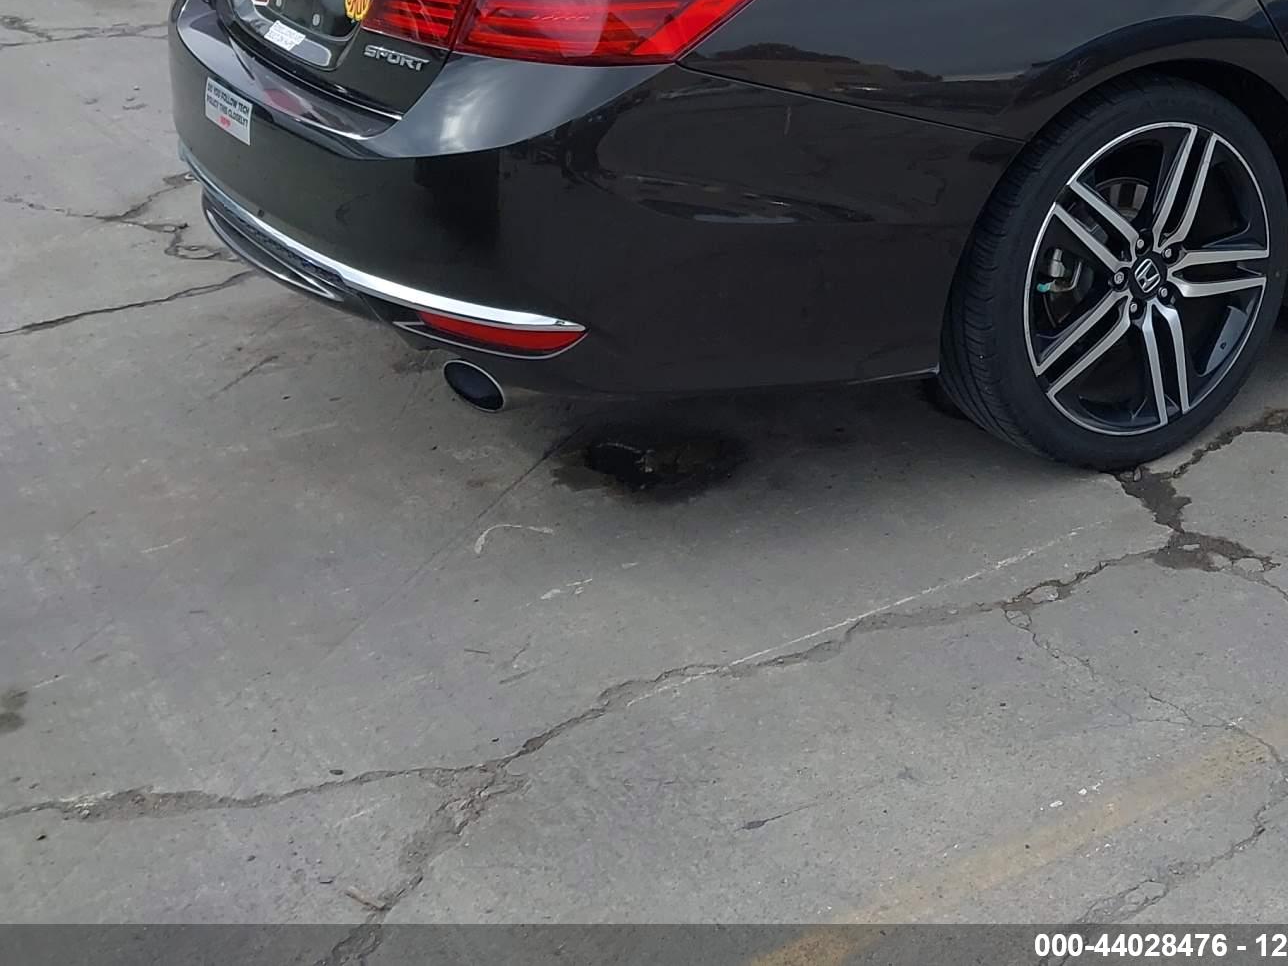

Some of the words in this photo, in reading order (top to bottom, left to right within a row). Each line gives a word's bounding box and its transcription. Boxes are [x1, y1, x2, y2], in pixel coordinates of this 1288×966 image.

[363, 44, 430, 71] SPORT
[220, 91, 238, 109] FOLLOW
[238, 102, 250, 116] TECH
